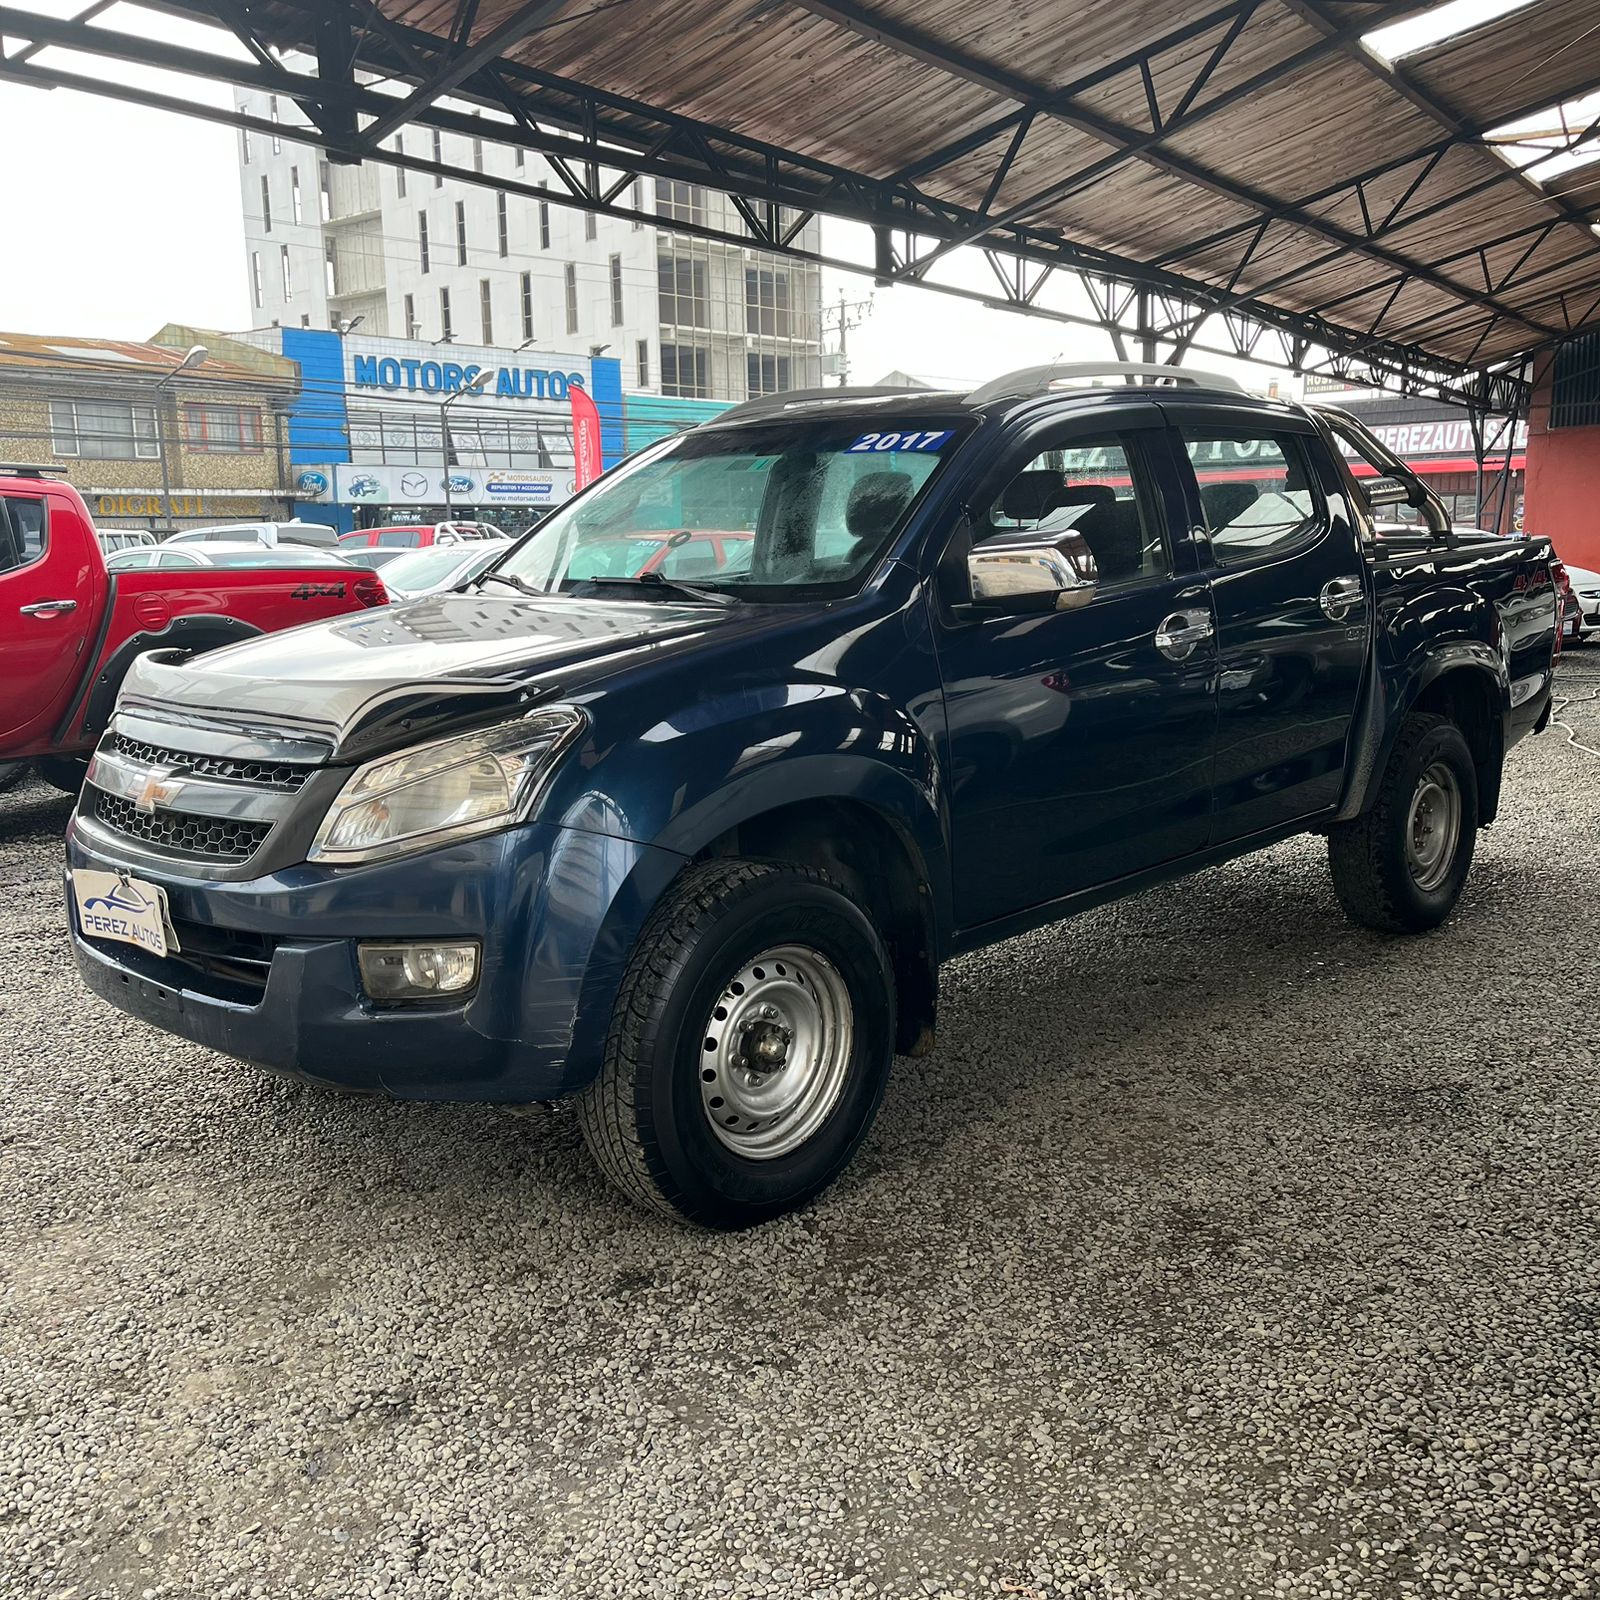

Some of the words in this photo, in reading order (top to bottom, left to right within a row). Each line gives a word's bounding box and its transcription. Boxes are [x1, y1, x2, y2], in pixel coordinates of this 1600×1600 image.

[354, 355, 485, 397] MOTORS
[495, 367, 584, 400] AUTOS
[850, 430, 946, 450] 2017
[302, 475, 323, 491] Ford
[448, 478, 469, 492] Ford
[507, 474, 553, 483] MOTORSAUTOS
[84, 914, 130, 937] PEREZ
[132, 922, 163, 950] AUTOS
